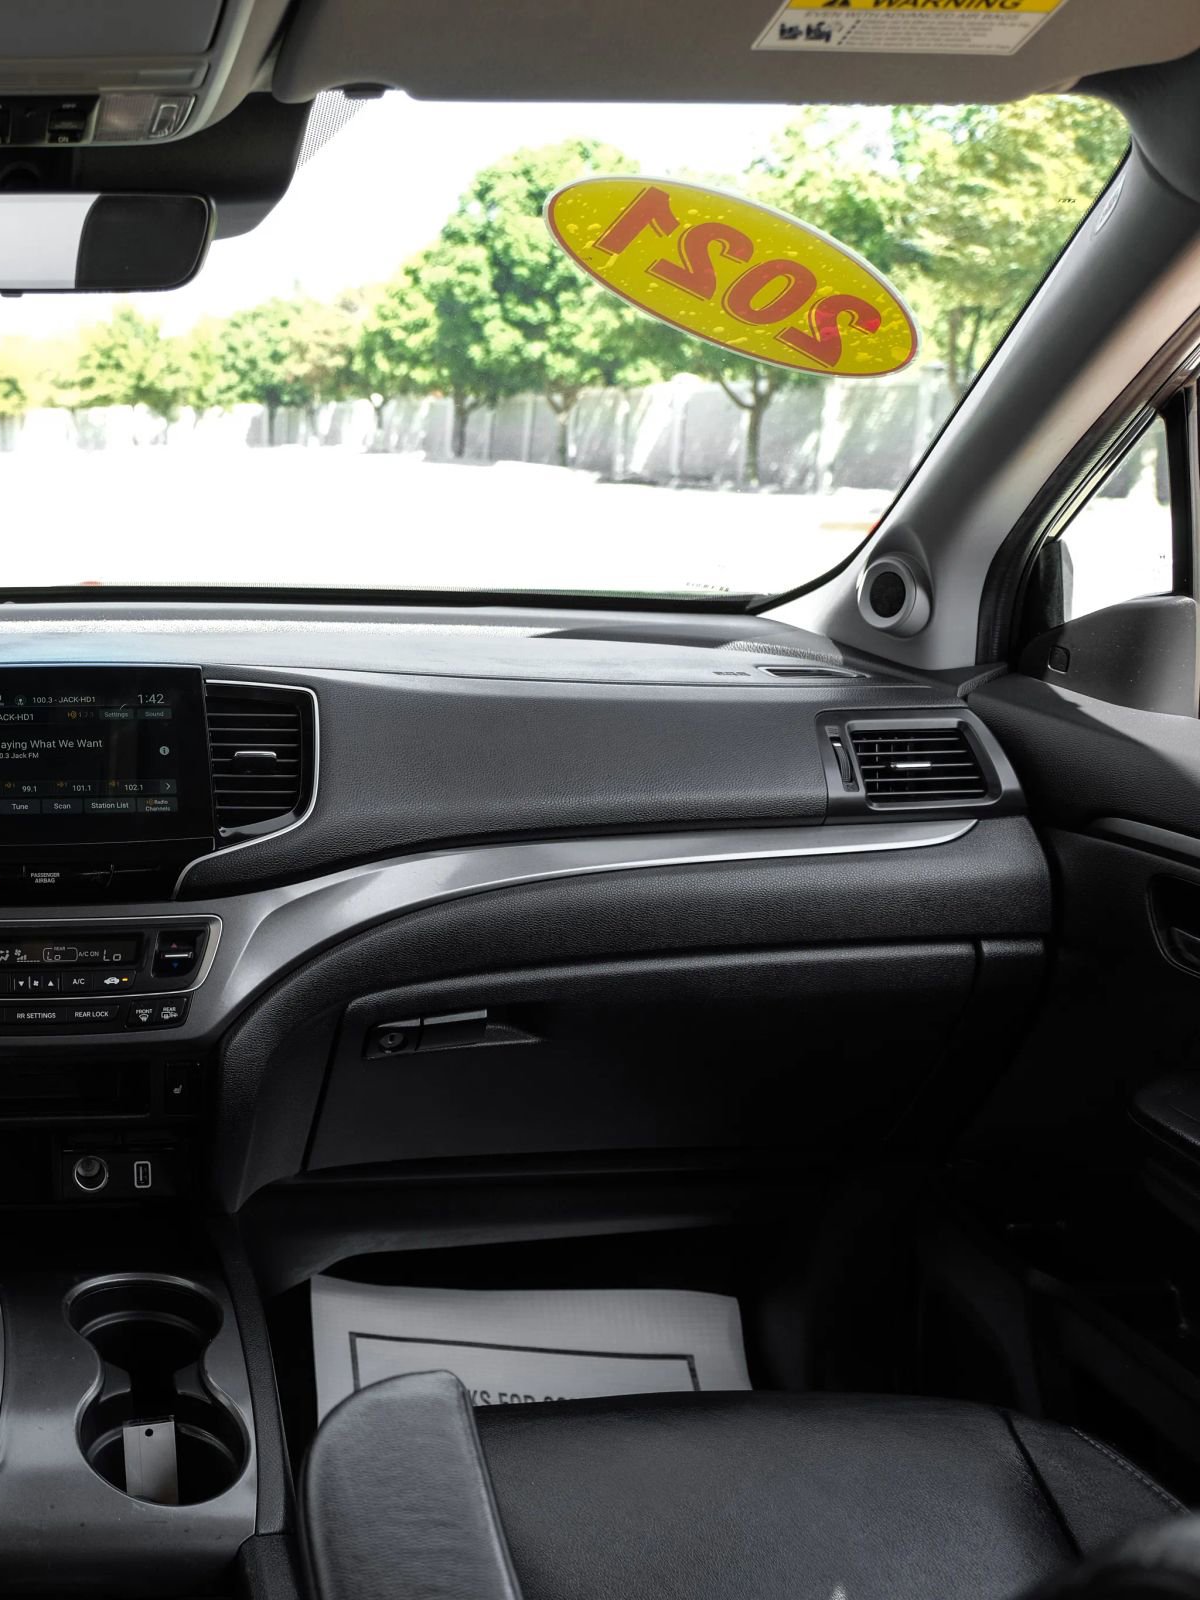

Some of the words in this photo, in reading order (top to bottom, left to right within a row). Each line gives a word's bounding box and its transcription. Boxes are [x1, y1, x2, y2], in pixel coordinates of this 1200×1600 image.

[872, 0, 1022, 10] WARNING
[32, 696, 53, 704] 100.3
[58, 696, 96, 704] JACK-HD1
[137, 693, 165, 705] 1:42
[30, 739, 56, 748] What
[59, 739, 74, 748] We
[77, 738, 103, 748] Want
